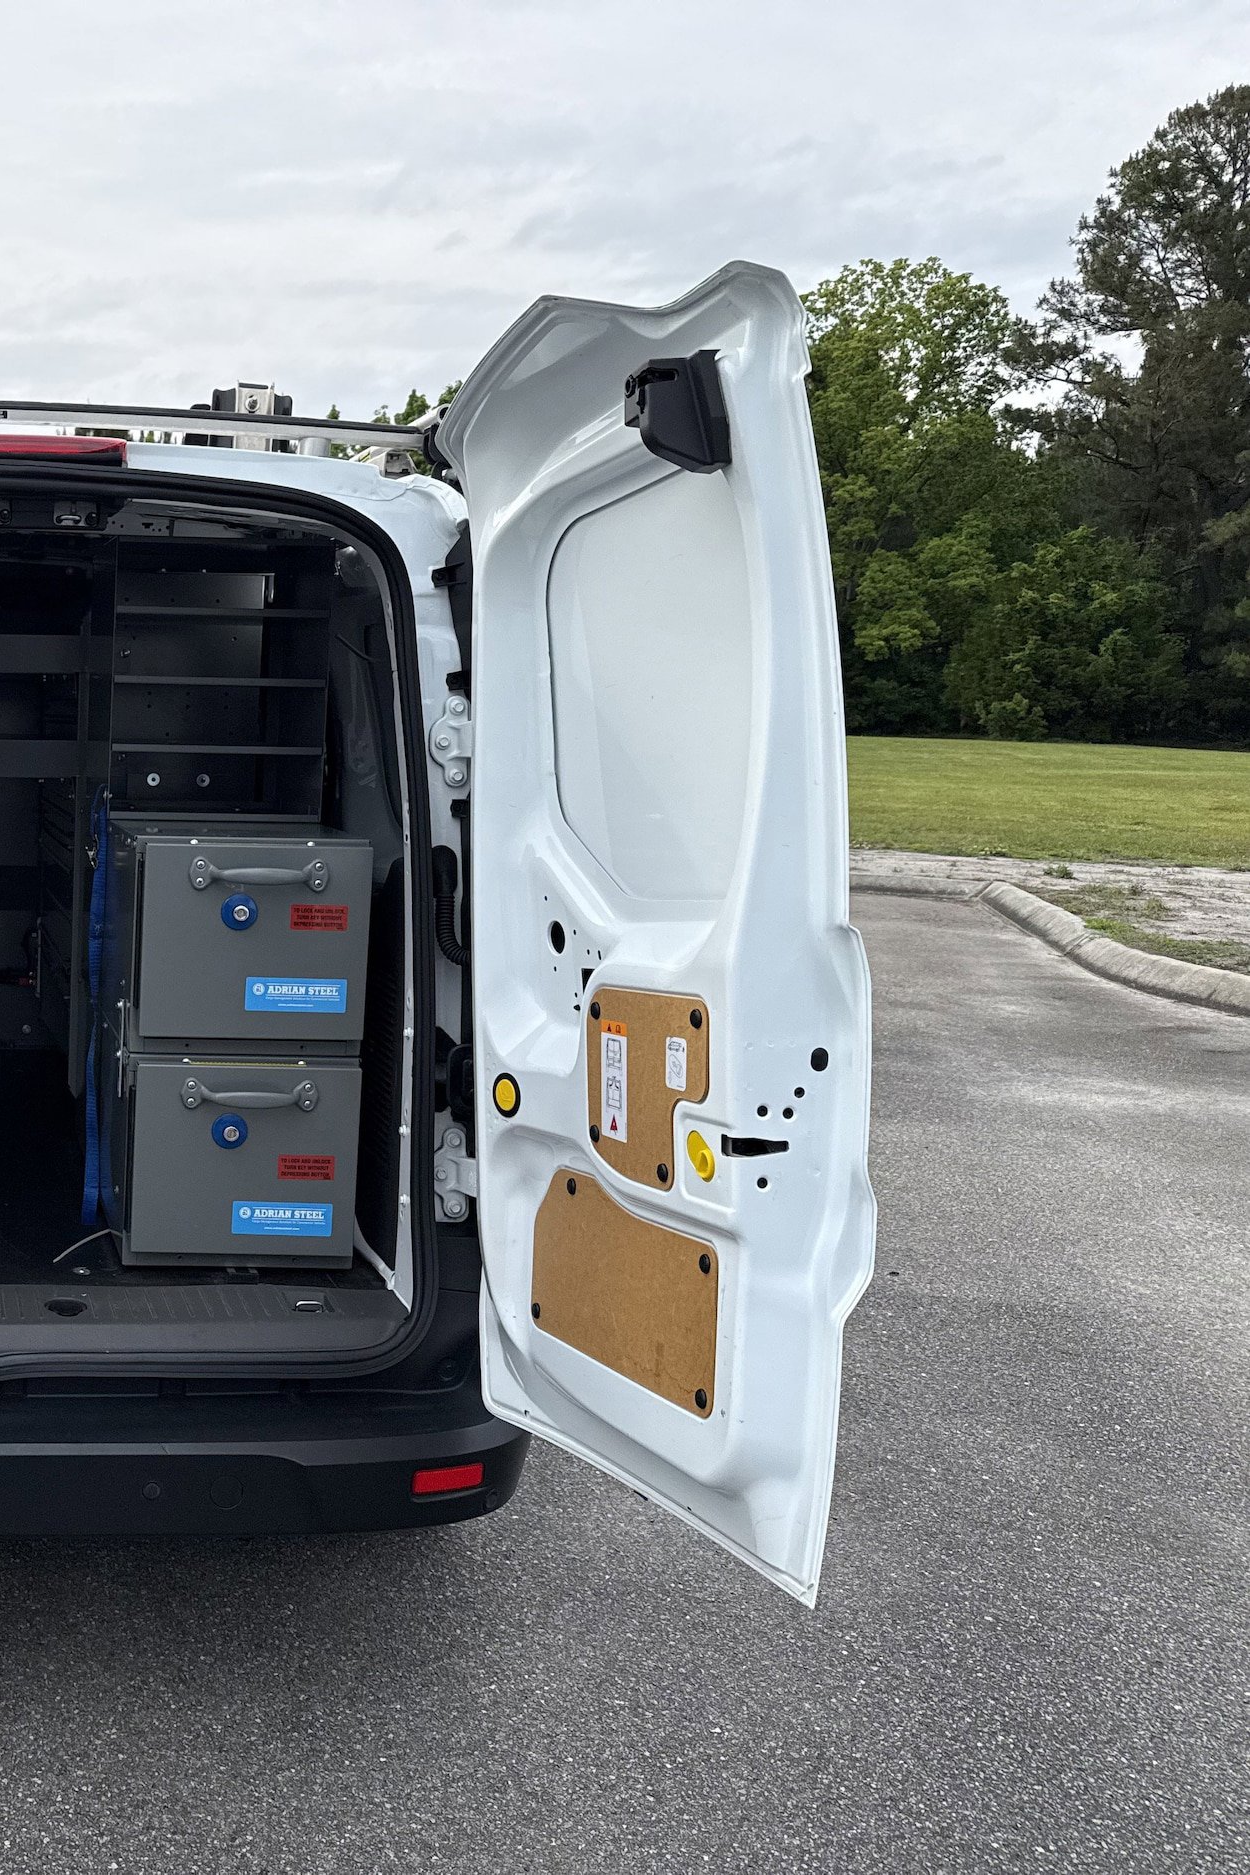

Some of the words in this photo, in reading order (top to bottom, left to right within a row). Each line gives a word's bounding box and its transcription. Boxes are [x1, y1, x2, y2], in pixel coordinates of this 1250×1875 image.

[267, 985, 306, 995] ADRIAN
[308, 986, 339, 996] STEEL
[254, 1209, 292, 1219] ADRIAN
[294, 1210, 325, 1220] STEEL
